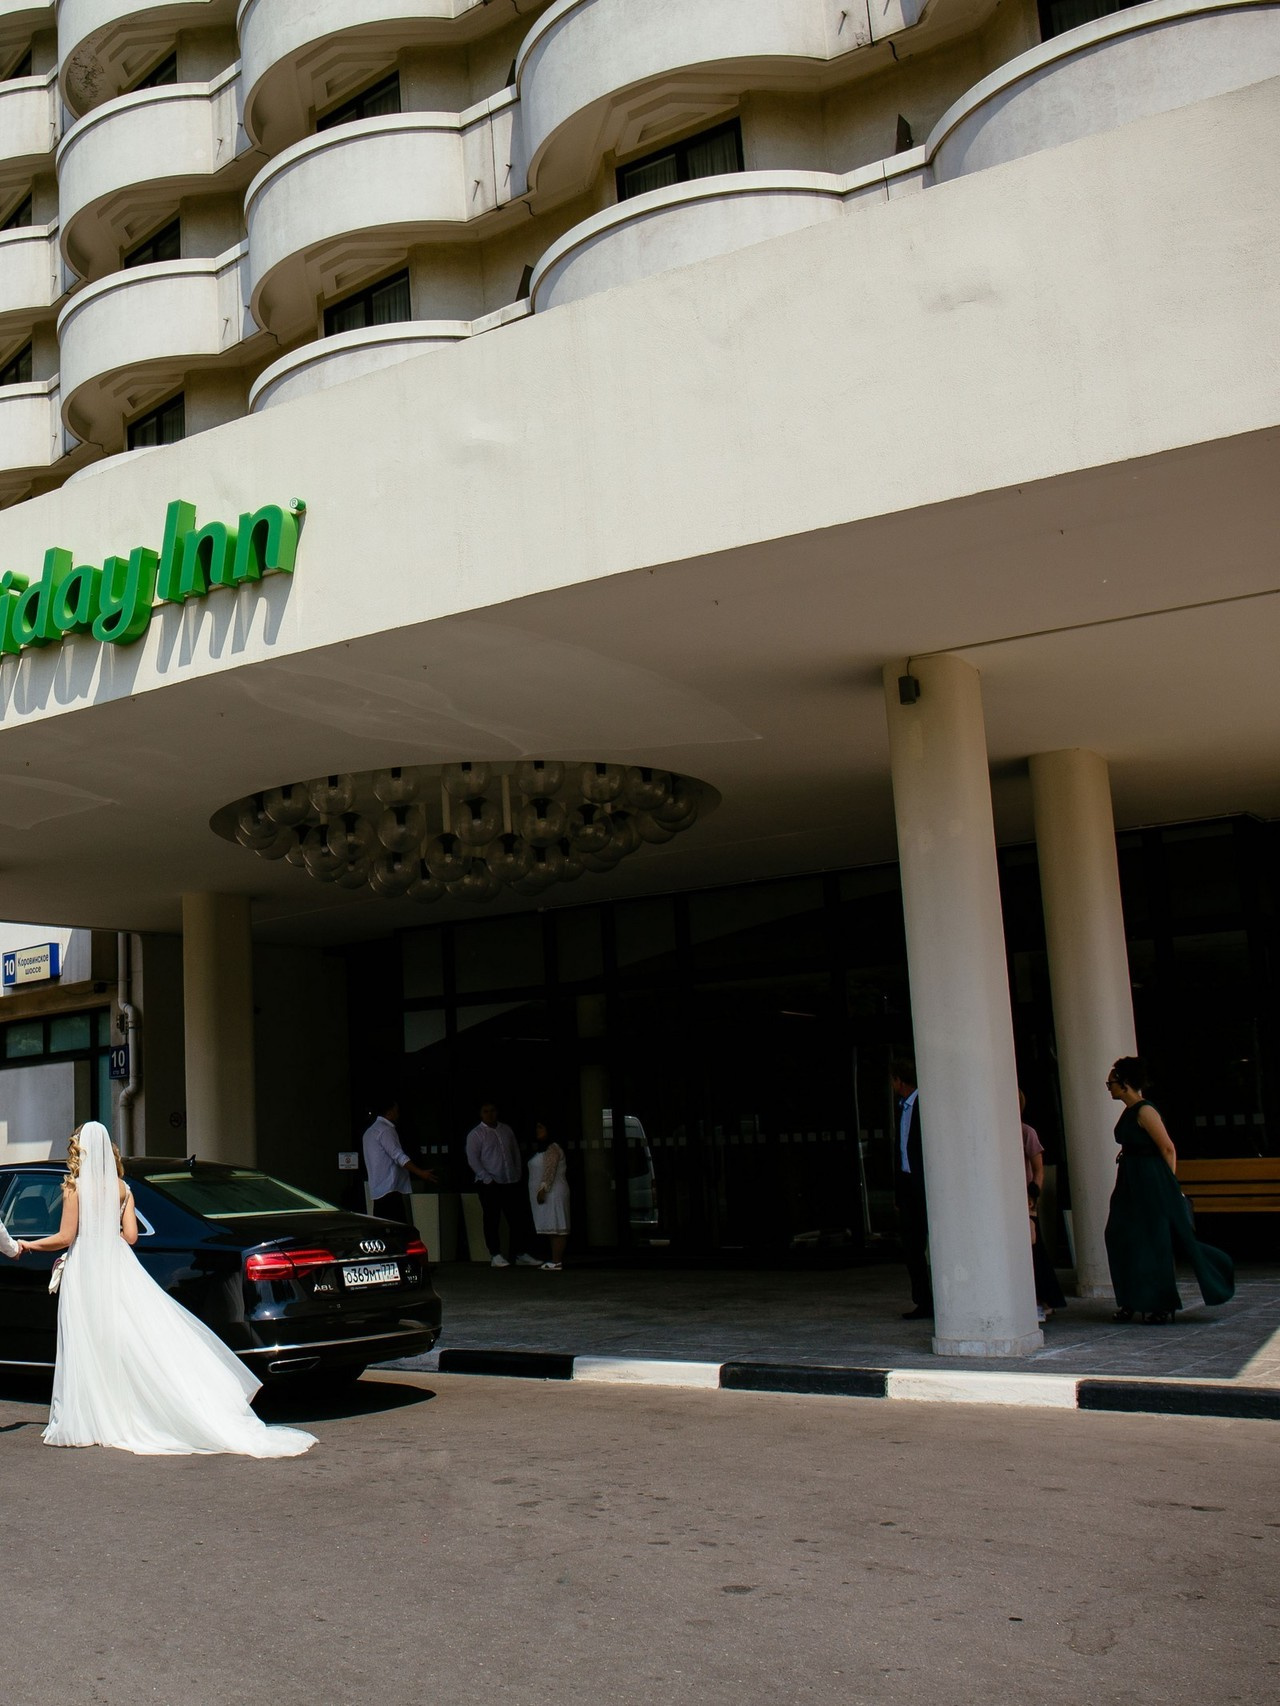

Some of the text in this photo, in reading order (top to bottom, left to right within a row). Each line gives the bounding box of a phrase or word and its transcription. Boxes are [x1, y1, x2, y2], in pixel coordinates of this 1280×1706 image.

[157, 499, 300, 603] Inn
[4, 959, 15, 976] 10
[17, 954, 49, 968] Коровинское
[24, 966, 42, 975] шоссе
[111, 1049, 126, 1068] 10
